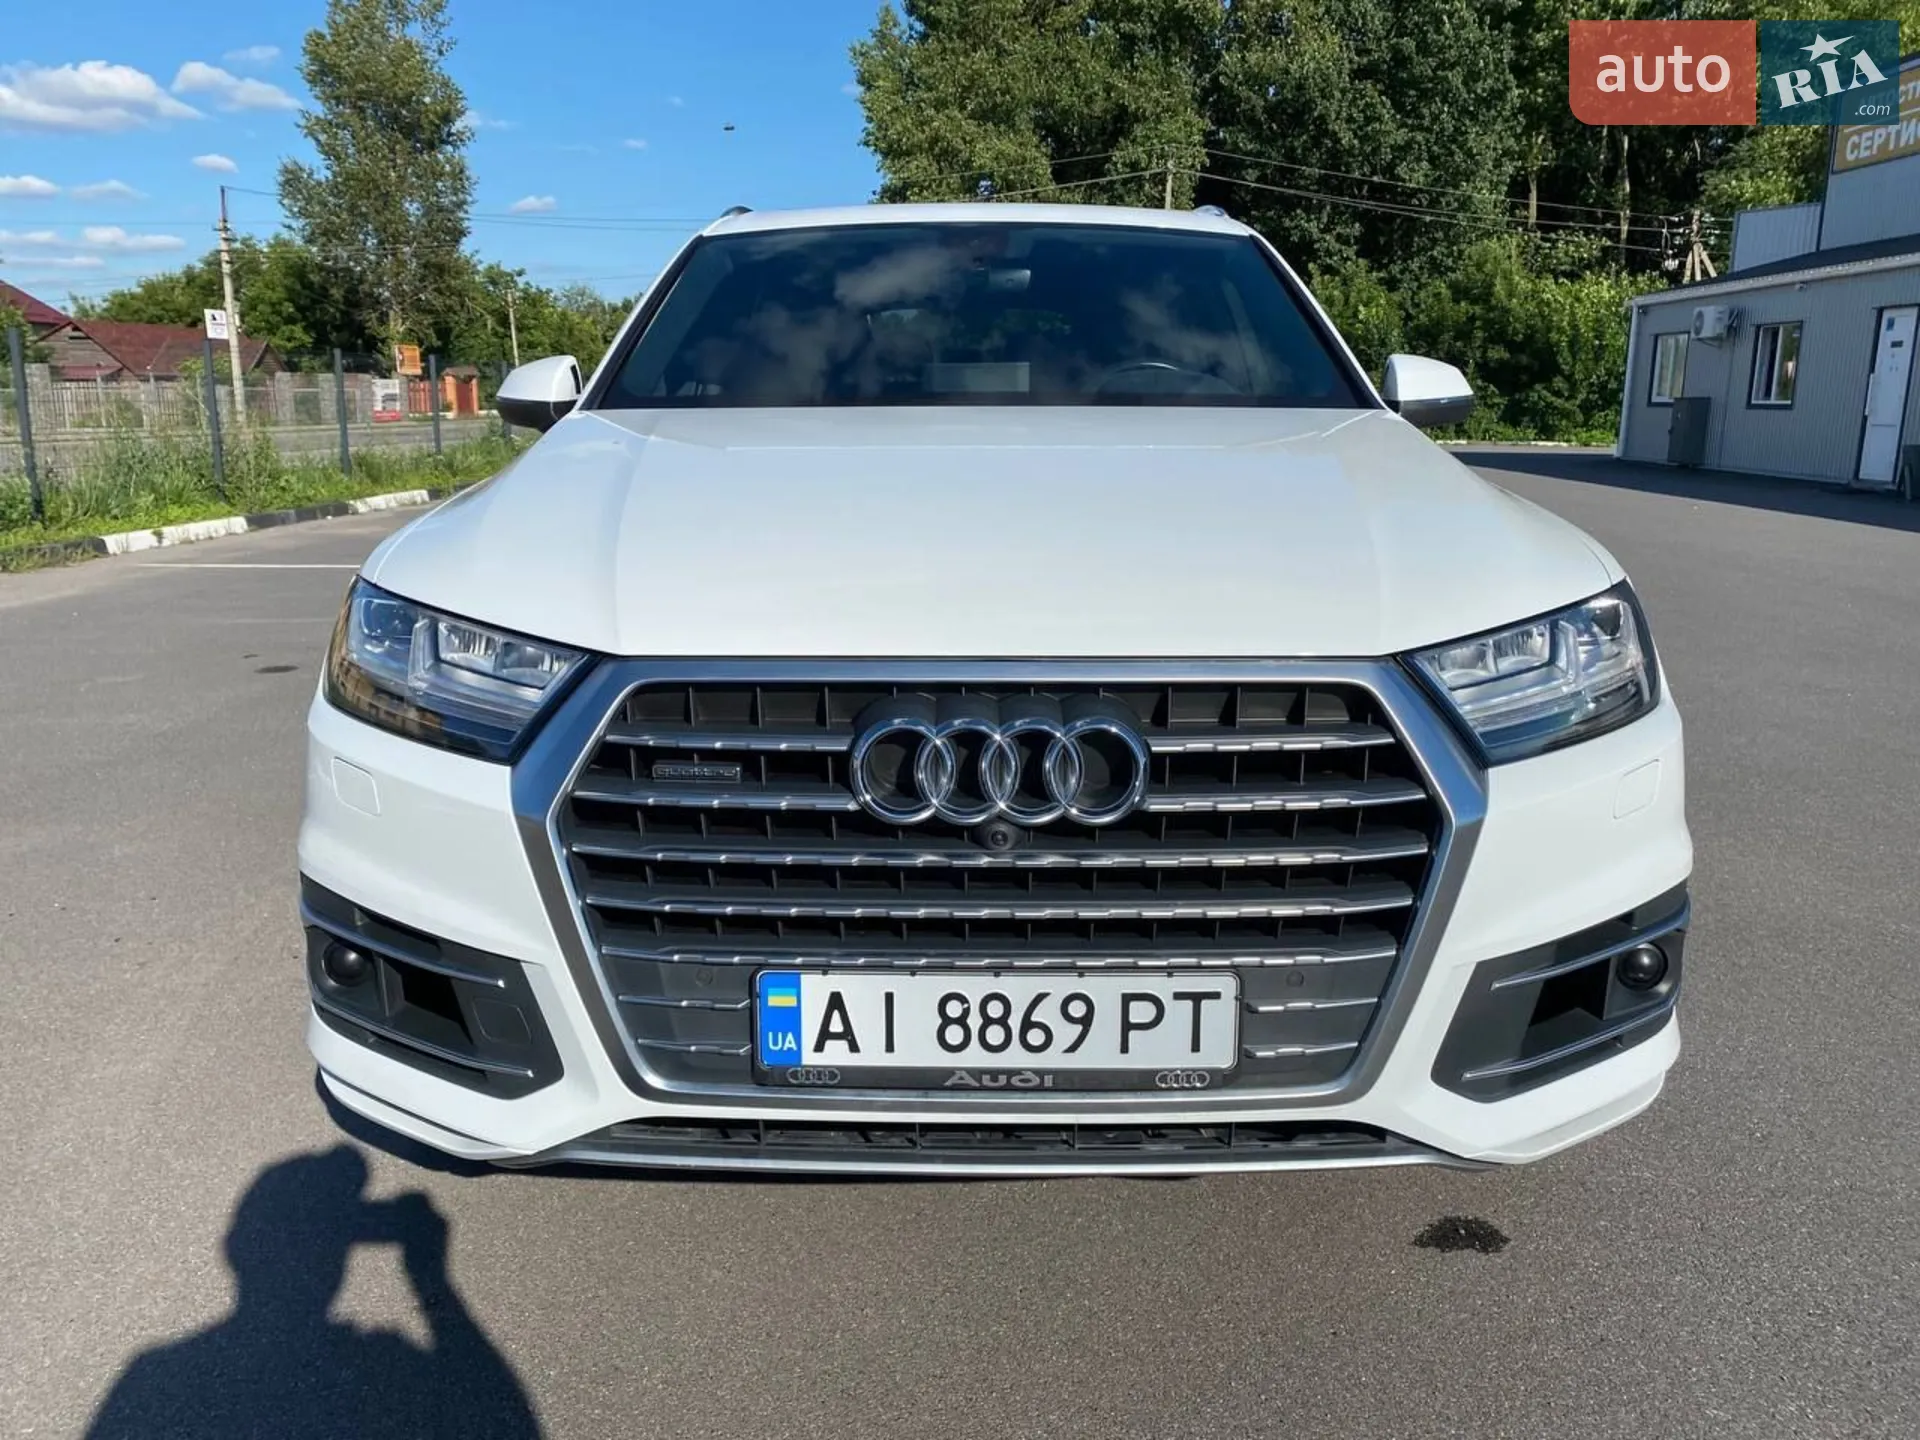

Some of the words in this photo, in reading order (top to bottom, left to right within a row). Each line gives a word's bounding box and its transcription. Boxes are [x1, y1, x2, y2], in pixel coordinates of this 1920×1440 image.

[1845, 117, 1920, 161] СЕРТИ
[812, 991, 895, 1054] AI
[936, 991, 1096, 1054] 8869
[1119, 991, 1222, 1054] PT
[768, 1032, 797, 1050] UA
[943, 1070, 1053, 1088] Audi
